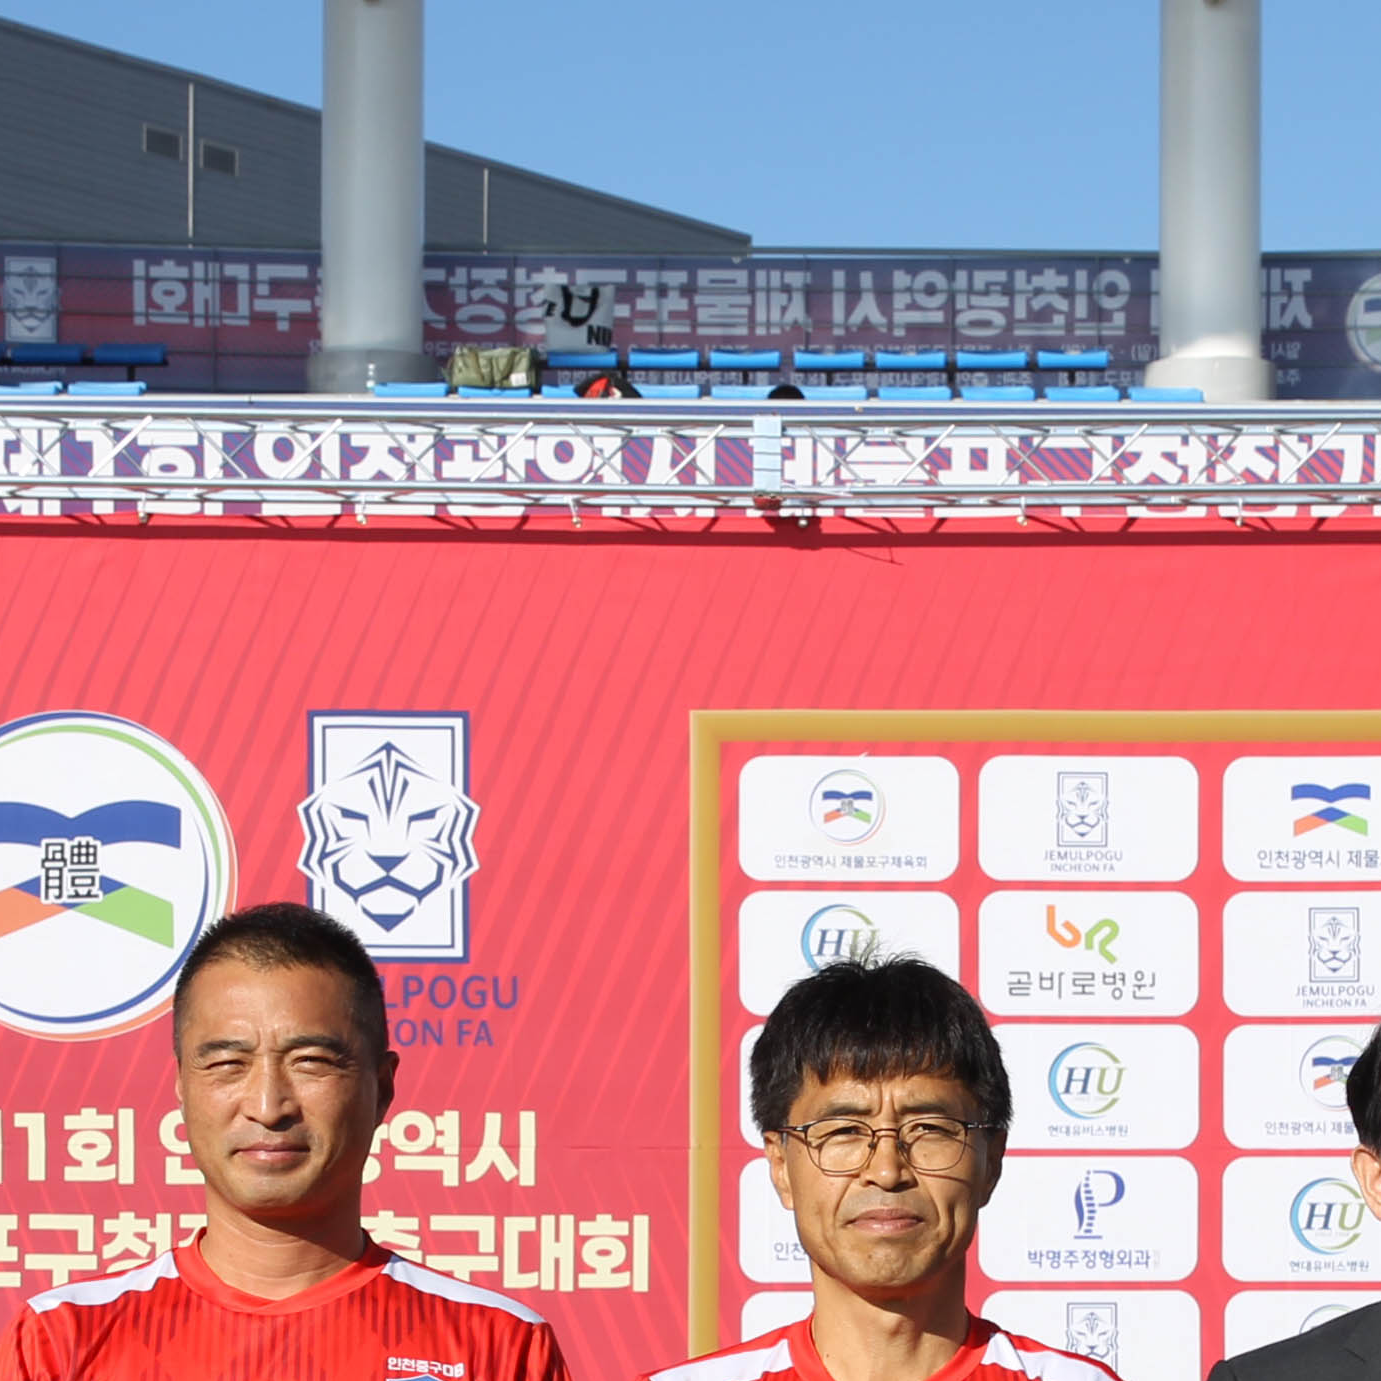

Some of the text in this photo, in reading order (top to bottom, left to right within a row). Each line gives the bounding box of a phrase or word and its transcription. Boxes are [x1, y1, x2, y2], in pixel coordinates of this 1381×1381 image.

[774, 855, 837, 869] 인천광역시
[1044, 849, 1124, 862] JEMULPOGU
[1257, 849, 1341, 869] 인천광역시
[1050, 863, 1116, 873] INCHEON FA
[1007, 970, 1156, 1000] 곧바로병원
[1296, 985, 1375, 998] JEMULPOGU
[1302, 999, 1367, 1008] INCHEON FA
[458, 1020, 494, 1046] FA
[1027, 1249, 1151, 1269] 박명주정형외과
